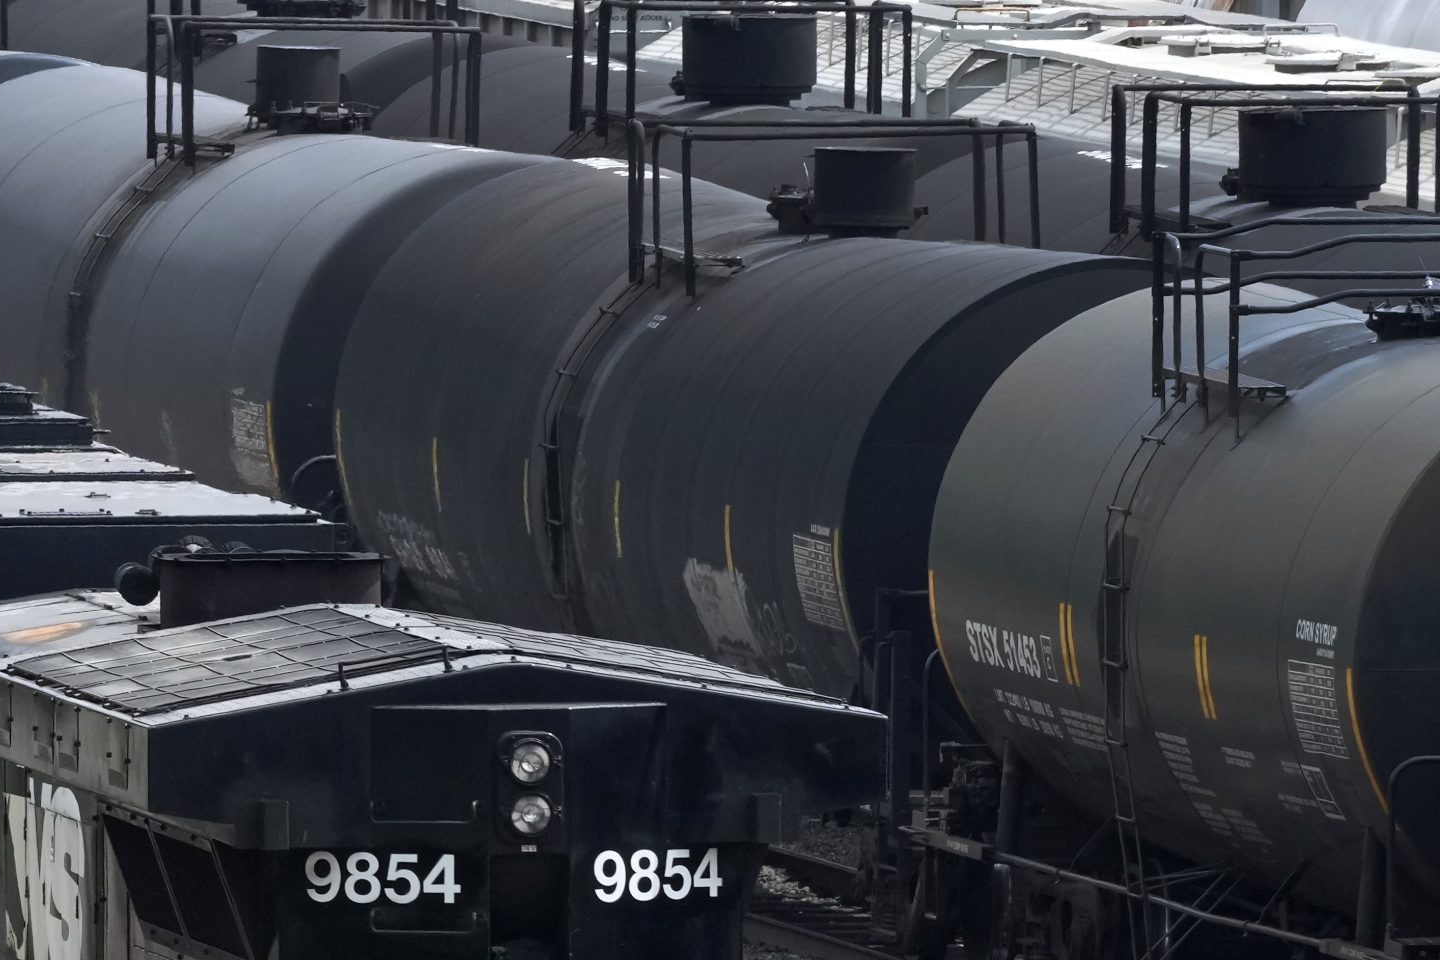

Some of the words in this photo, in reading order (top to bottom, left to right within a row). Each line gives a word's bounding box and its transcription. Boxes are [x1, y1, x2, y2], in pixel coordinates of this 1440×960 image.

[965, 619, 1005, 668] STSX
[1002, 630, 1041, 678] 51453
[1295, 618, 1315, 642] CORN
[1314, 622, 1338, 646] SYRUP
[305, 850, 462, 904] 9854
[593, 848, 723, 903] 9854
